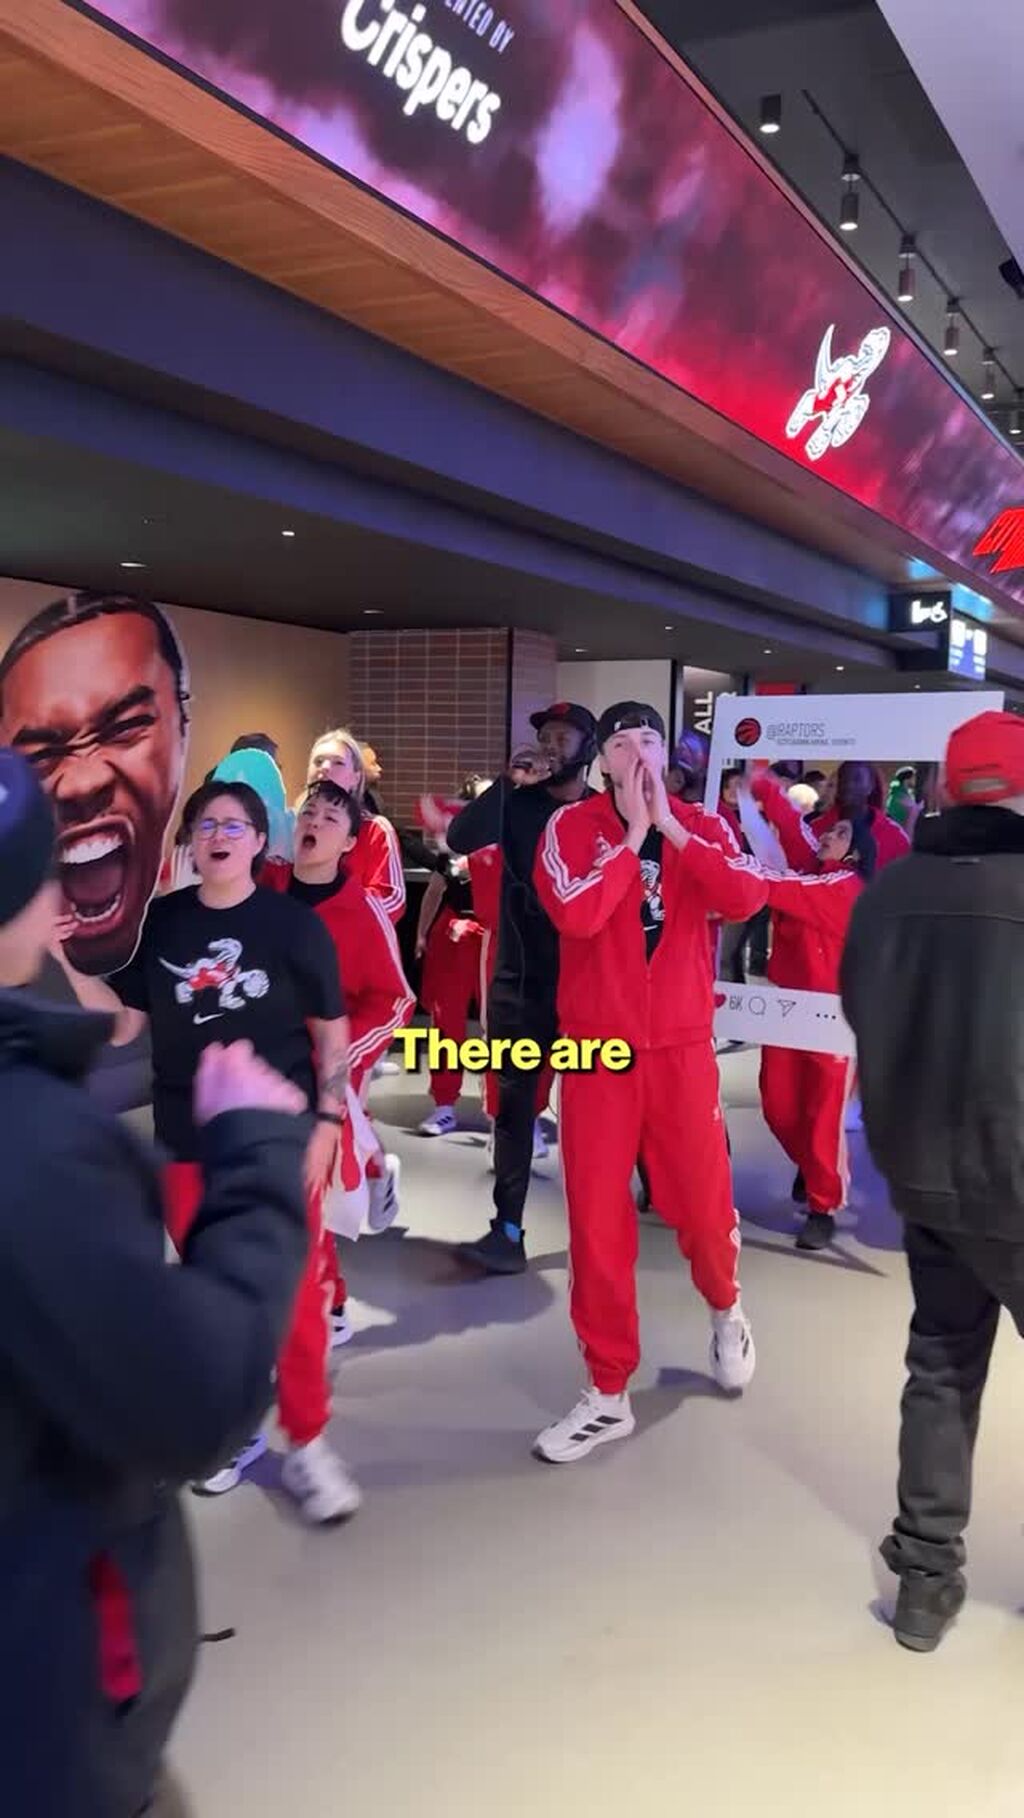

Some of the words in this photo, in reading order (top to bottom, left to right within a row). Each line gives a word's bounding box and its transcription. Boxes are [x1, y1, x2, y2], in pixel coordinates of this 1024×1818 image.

[490, 20, 514, 53] BY
[341, 0, 501, 144] Crispers
[693, 691, 712, 735] ALL
[766, 722, 826, 740] @RAPTORS
